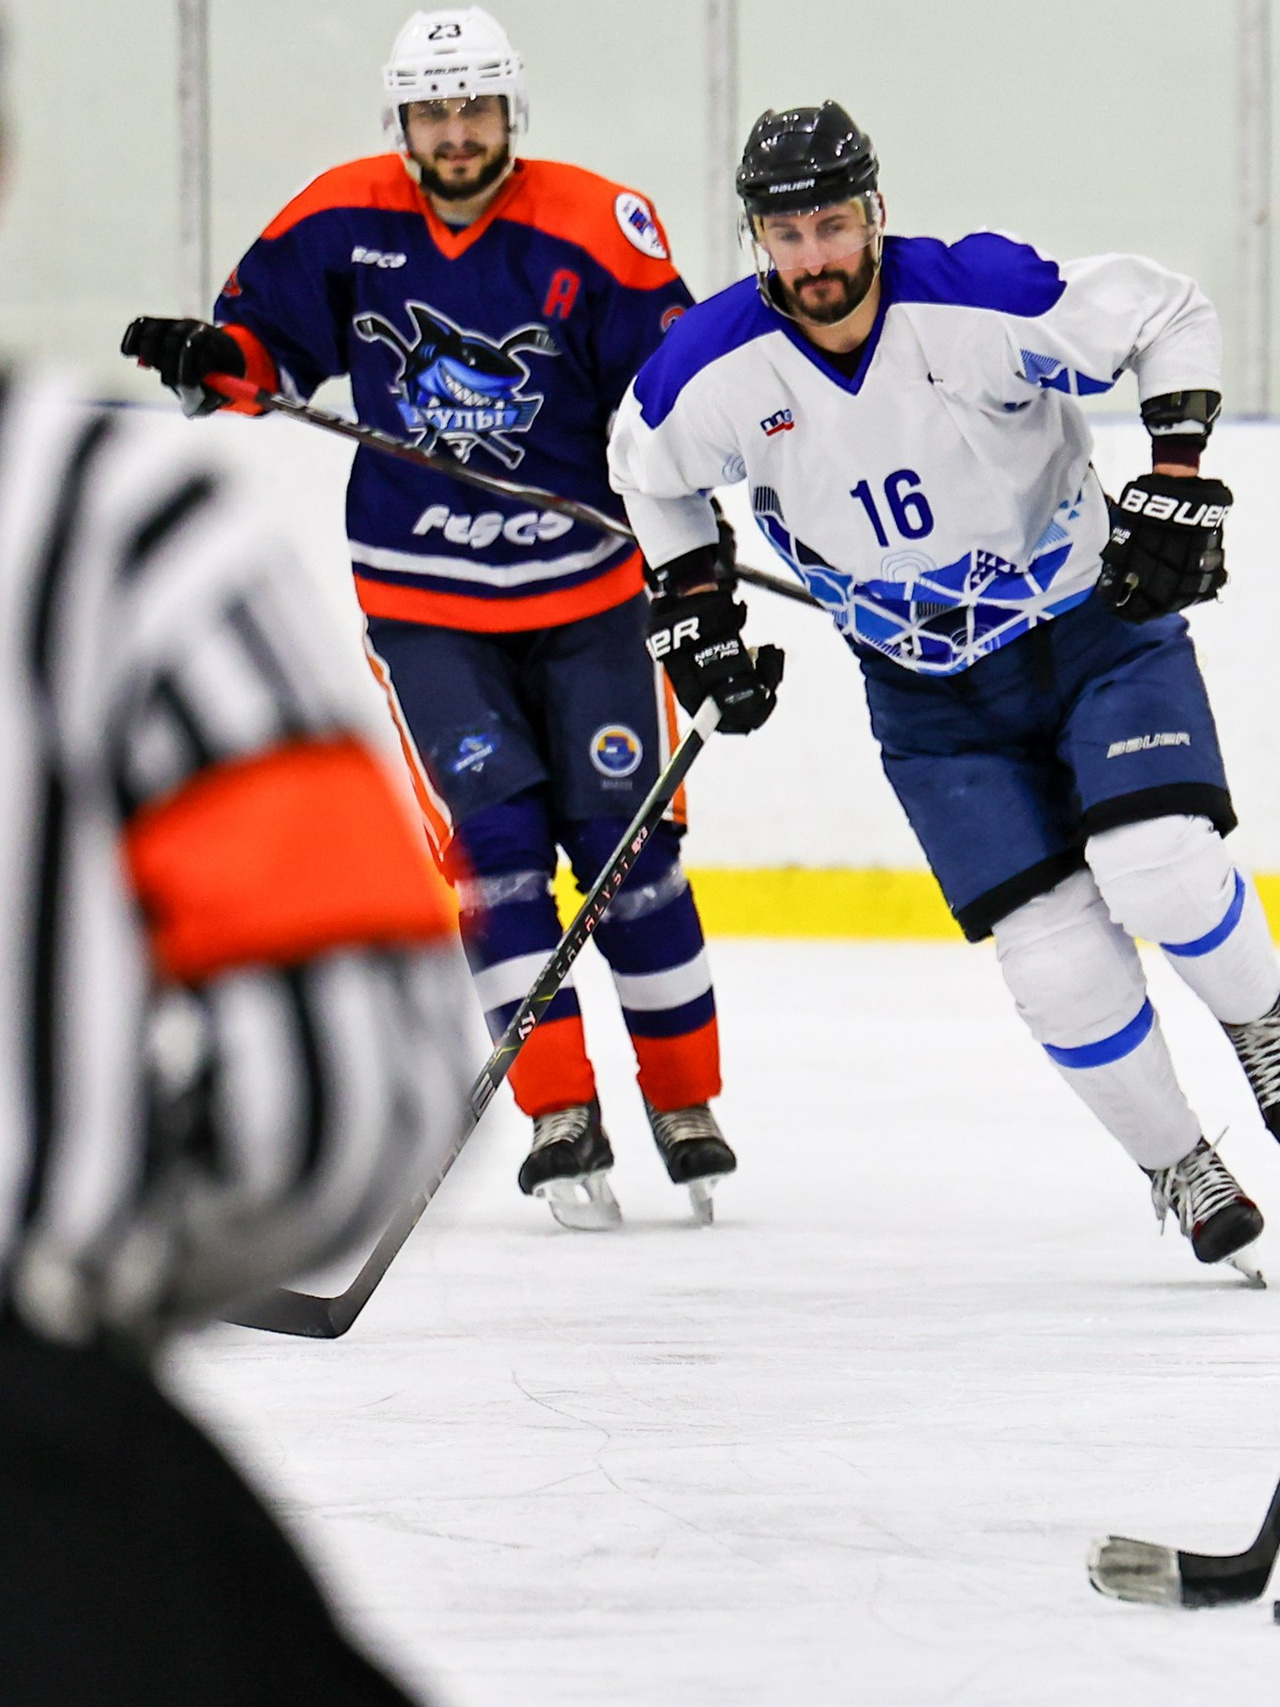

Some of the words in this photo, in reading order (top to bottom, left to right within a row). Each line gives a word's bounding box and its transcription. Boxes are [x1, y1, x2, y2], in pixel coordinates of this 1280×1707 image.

[428, 23, 461, 40] 23
[769, 178, 816, 194] BAUER
[542, 268, 581, 320] A
[849, 468, 935, 548] 16
[694, 639, 740, 663] NEXUS
[1106, 731, 1191, 759] BAUER
[556, 857, 631, 980] CATALYST
